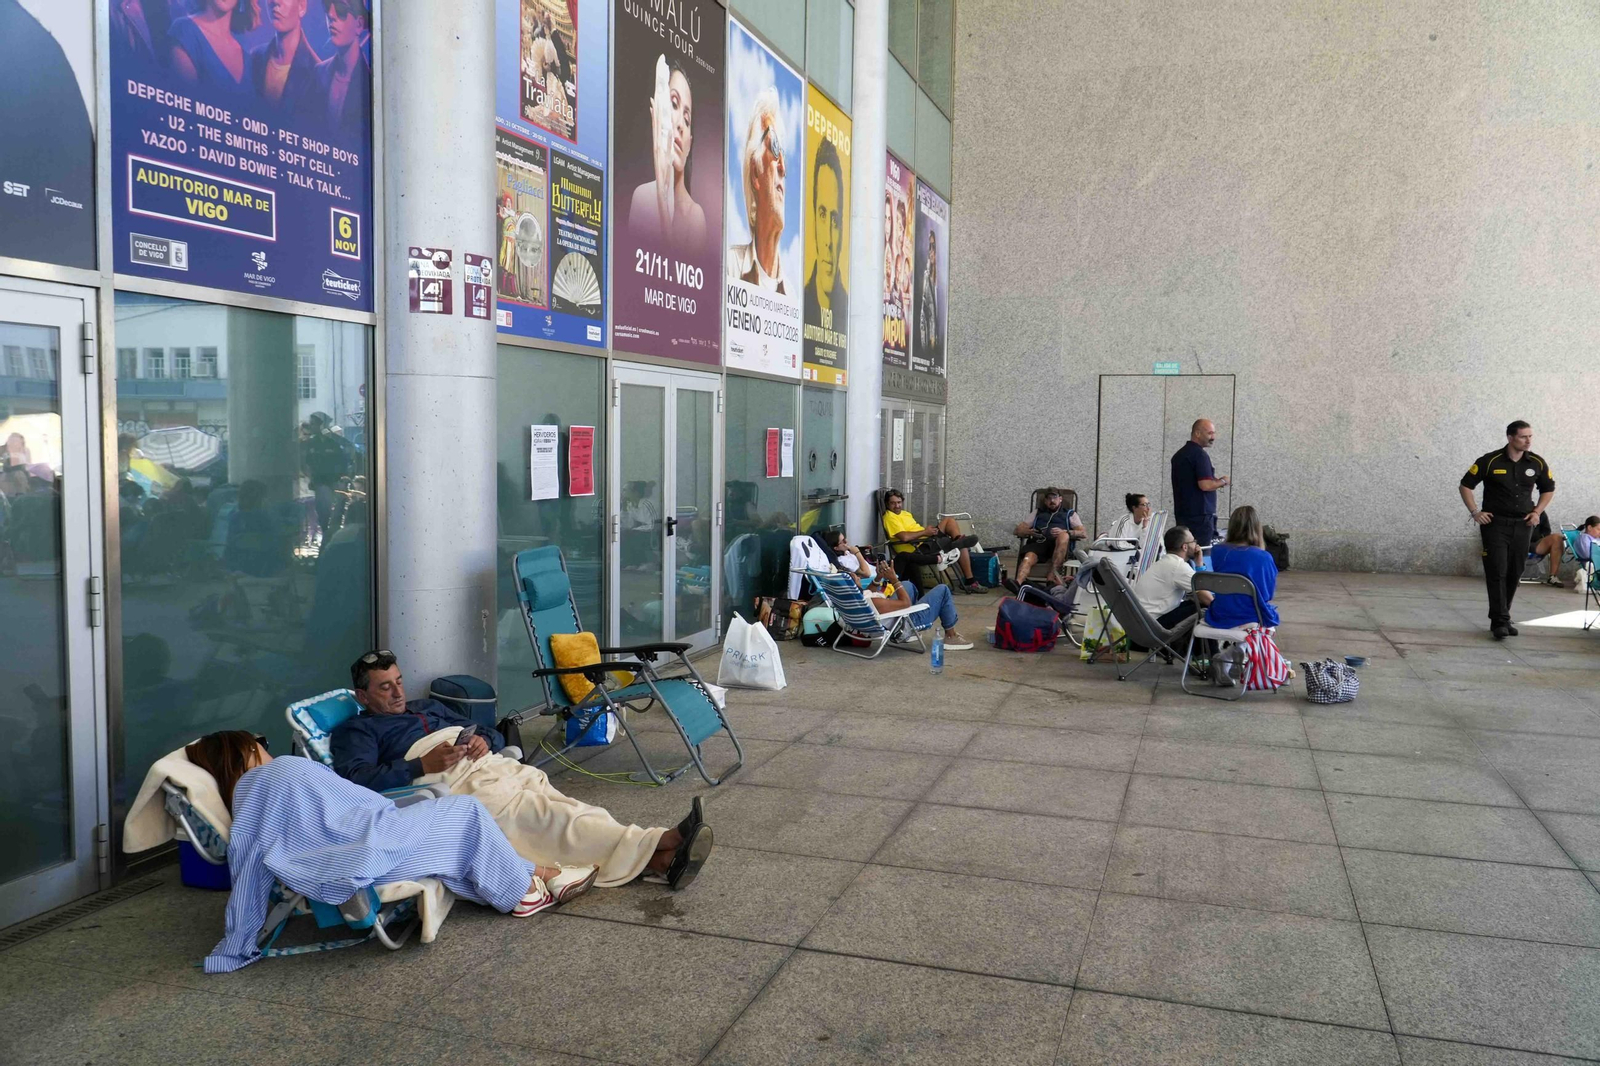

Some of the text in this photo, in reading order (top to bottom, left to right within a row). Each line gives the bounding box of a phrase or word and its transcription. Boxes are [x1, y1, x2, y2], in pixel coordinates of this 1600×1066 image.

[624, 0, 665, 38] QUINCE
[669, 29, 693, 59] TOUR
[523, 76, 574, 120] Traviata
[127, 79, 359, 166] DEPECHE MODE OMD PET SHOP BOYS
[807, 103, 851, 157] DEPEDRO
[141, 128, 187, 154] YAZOO
[199, 145, 236, 168] DAVID
[239, 157, 278, 180] BOWIE
[286, 170, 314, 190] TALK
[168, 114, 335, 177] U2 THE SMITHS SOFT CELL
[3, 180, 84, 209] SET JCDecaux
[136, 167, 270, 212] AUDITORIO MAR DE
[506, 173, 544, 199] Pagliacci
[185, 197, 228, 221] VIGO
[552, 182, 602, 222] BUTTERFLY
[338, 216, 352, 239] 6
[134, 240, 168, 252] CONCELLO
[138, 248, 164, 260] DE VIGO
[335, 239, 357, 253] NOV
[244, 272, 256, 280] MAR
[635, 248, 704, 290] 21/11. VIGO
[325, 277, 358, 292] teuticket
[644, 287, 697, 315] MAR DE VIGO
[727, 284, 748, 308] KIKO
[749, 293, 773, 312] AUDITORIO
[773, 301, 783, 314] MAR
[727, 307, 762, 335] VENENO
[725, 647, 766, 663] PRIARK
